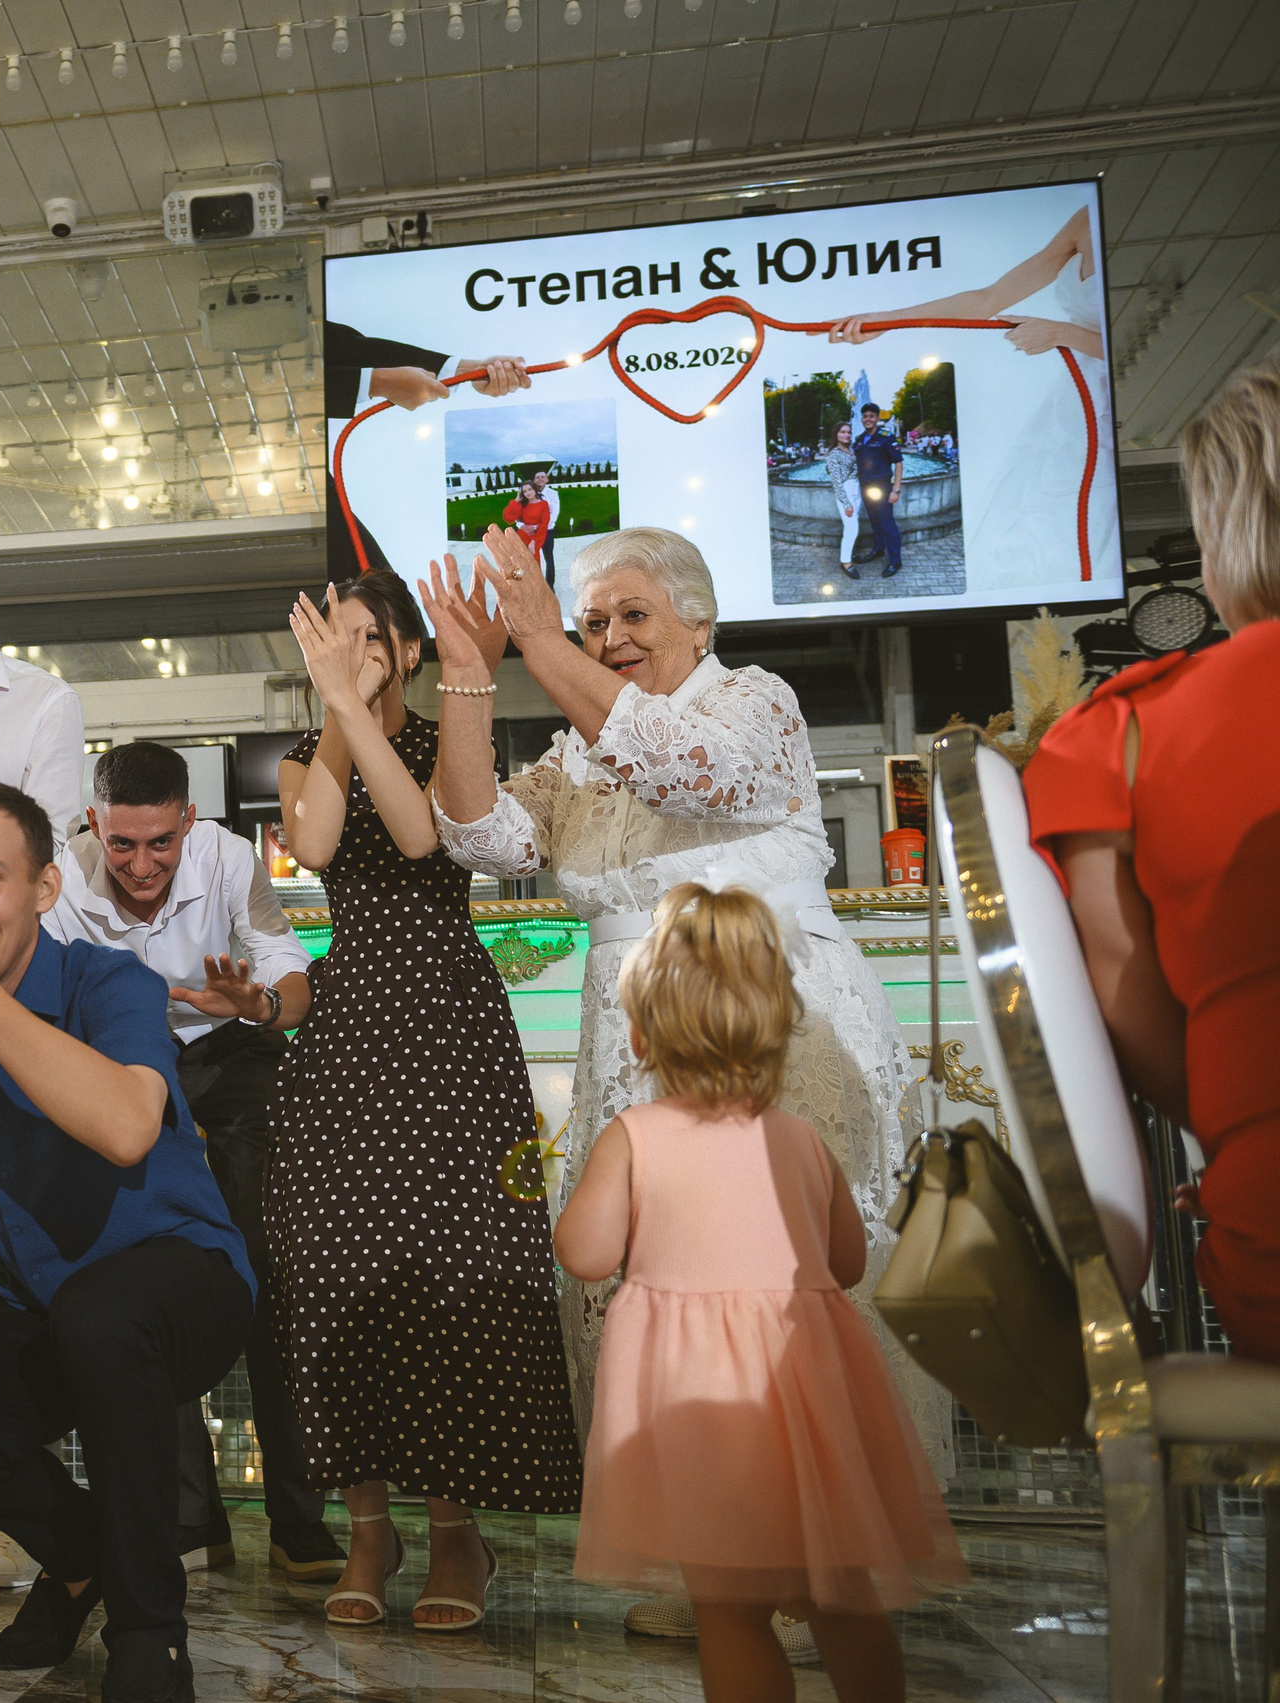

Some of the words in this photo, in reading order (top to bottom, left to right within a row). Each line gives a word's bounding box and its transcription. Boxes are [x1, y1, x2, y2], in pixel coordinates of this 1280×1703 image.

[465, 261, 681, 312] Степан
[699, 247, 739, 289] &
[757, 235, 942, 285] Юлия
[625, 346, 752, 373] 8.08.2026
